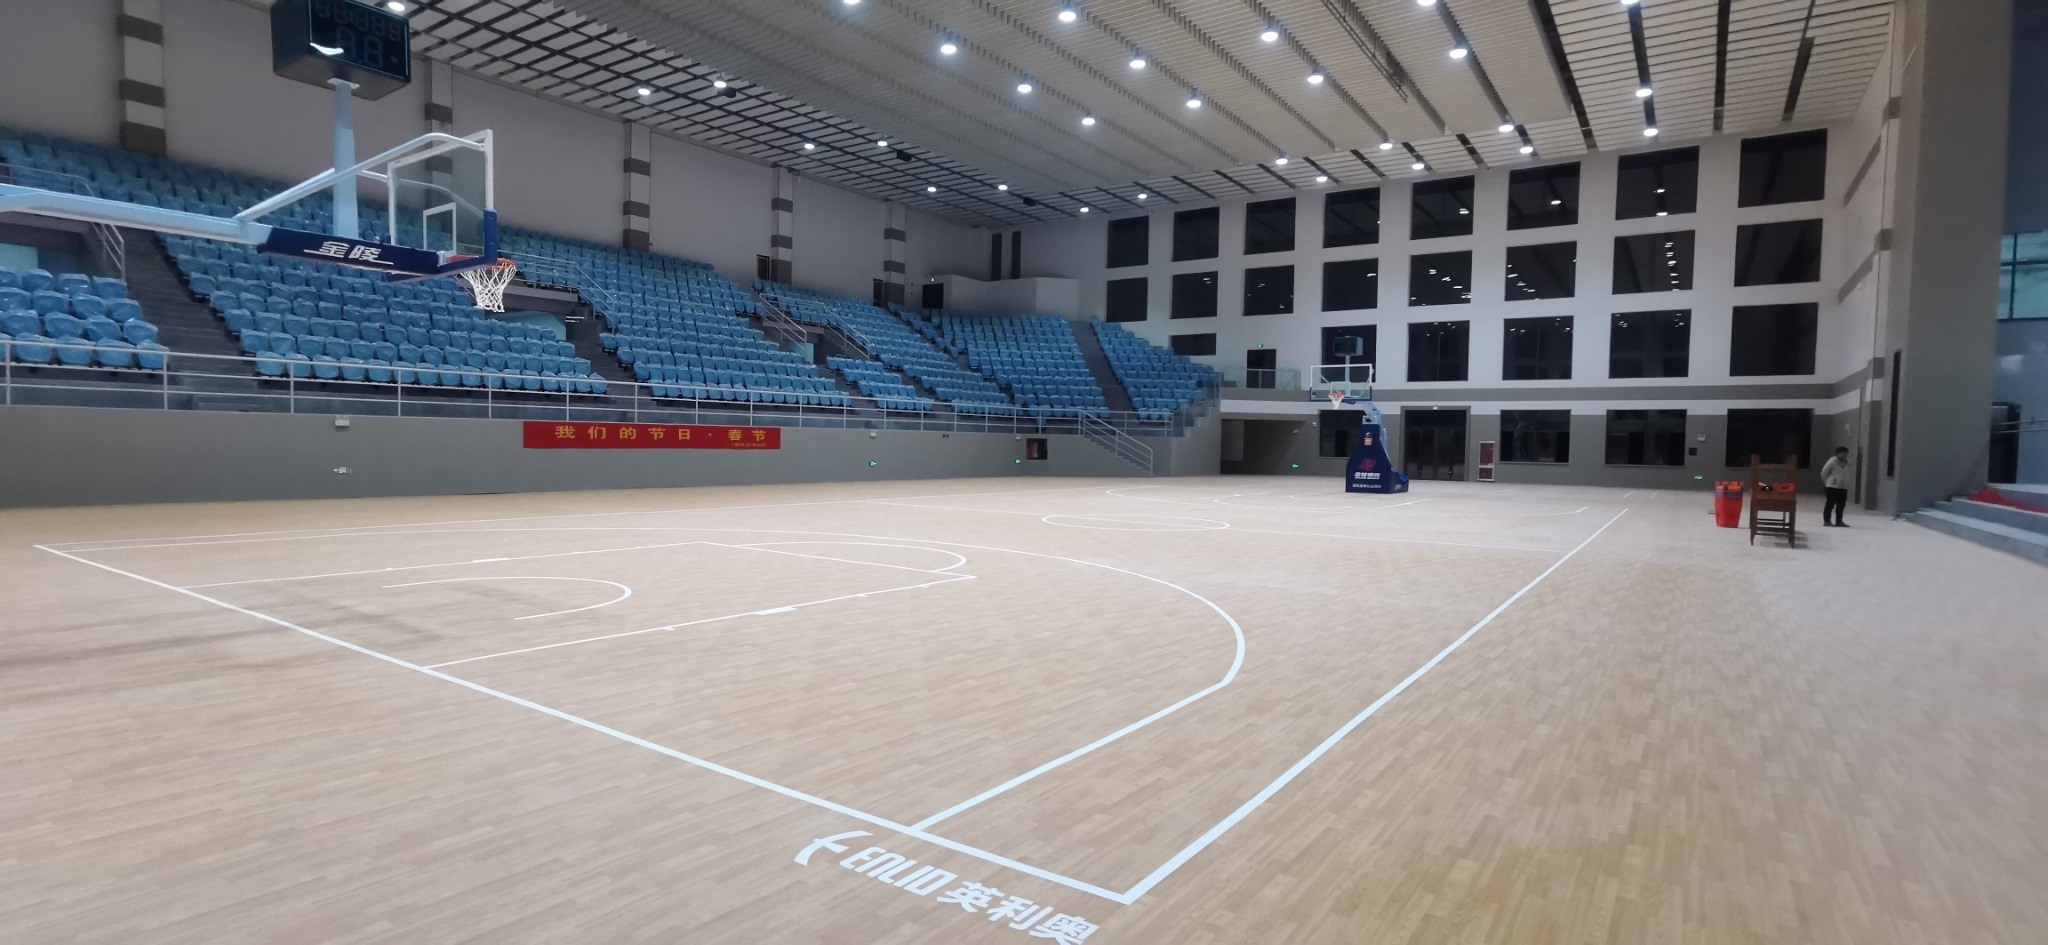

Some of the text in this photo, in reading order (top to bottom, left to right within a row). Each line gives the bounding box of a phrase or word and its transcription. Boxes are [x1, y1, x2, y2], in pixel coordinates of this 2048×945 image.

[303, 241, 394, 265] 金陵
[937, 880, 1099, 945] 英利奥
